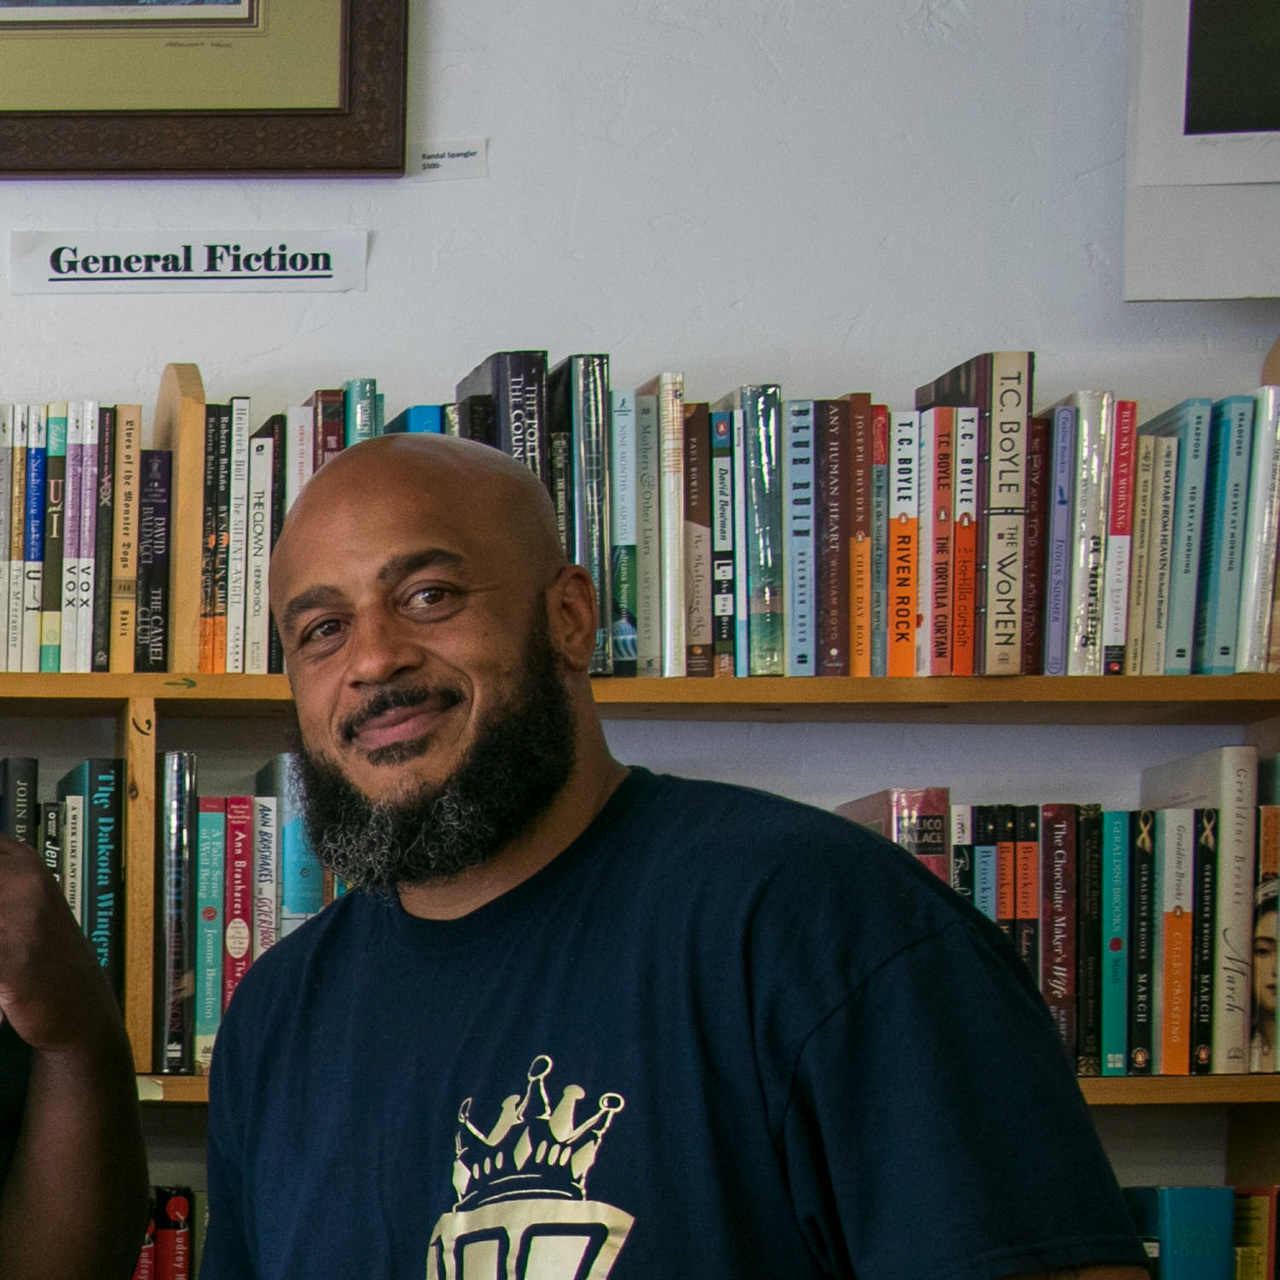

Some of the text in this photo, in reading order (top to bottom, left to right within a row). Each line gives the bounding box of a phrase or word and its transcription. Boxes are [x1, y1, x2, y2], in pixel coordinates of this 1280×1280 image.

[50, 243, 332, 274] General Fiction
[998, 372, 1021, 494] T.C. BOYLE
[894, 535, 911, 644] RIVEN ROCK
[995, 525, 1018, 647] THE WOMEN
[257, 803, 274, 884] ANN BRASHARES
